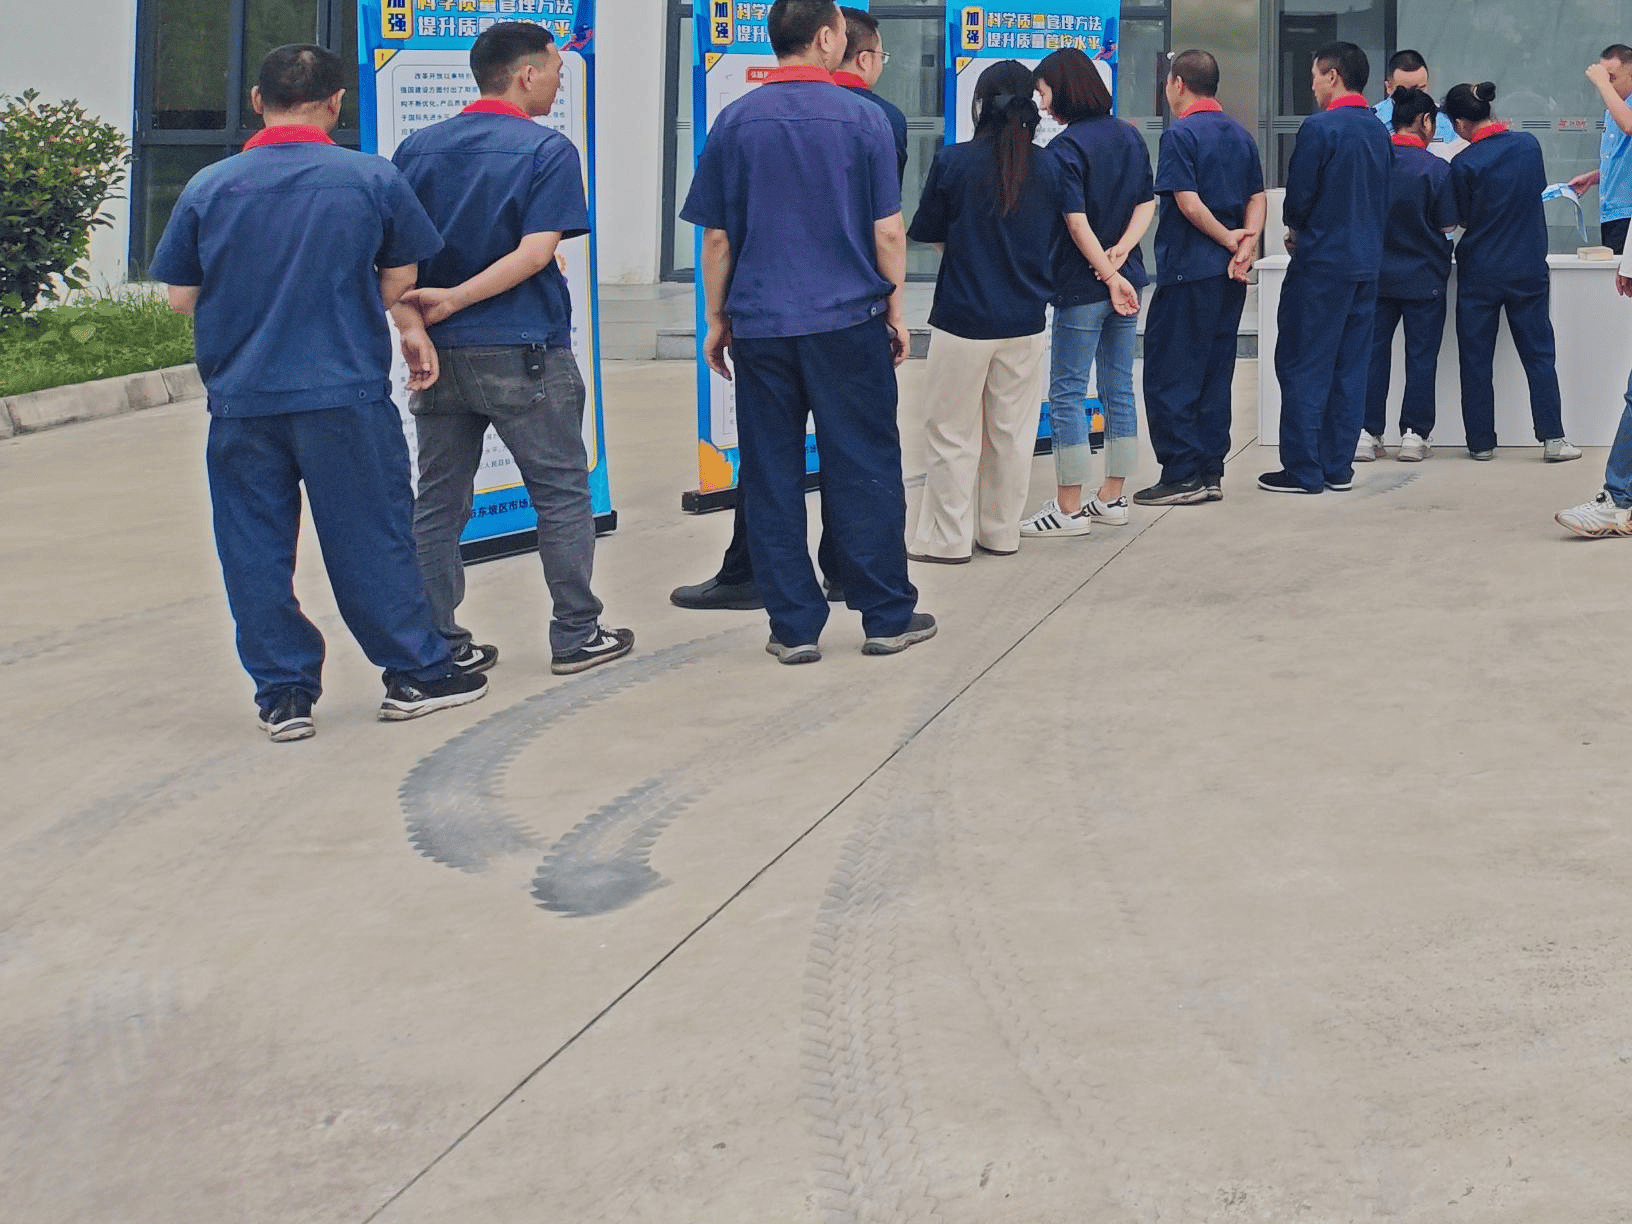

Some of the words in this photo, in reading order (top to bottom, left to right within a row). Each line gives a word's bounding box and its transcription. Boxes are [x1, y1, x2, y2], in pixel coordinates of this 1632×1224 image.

[736, 2, 773, 21] 科学
[986, 12, 1102, 31] 科学质量管理方法
[737, 24, 771, 43] 提升
[986, 31, 1101, 50] 提升质量管控水平
